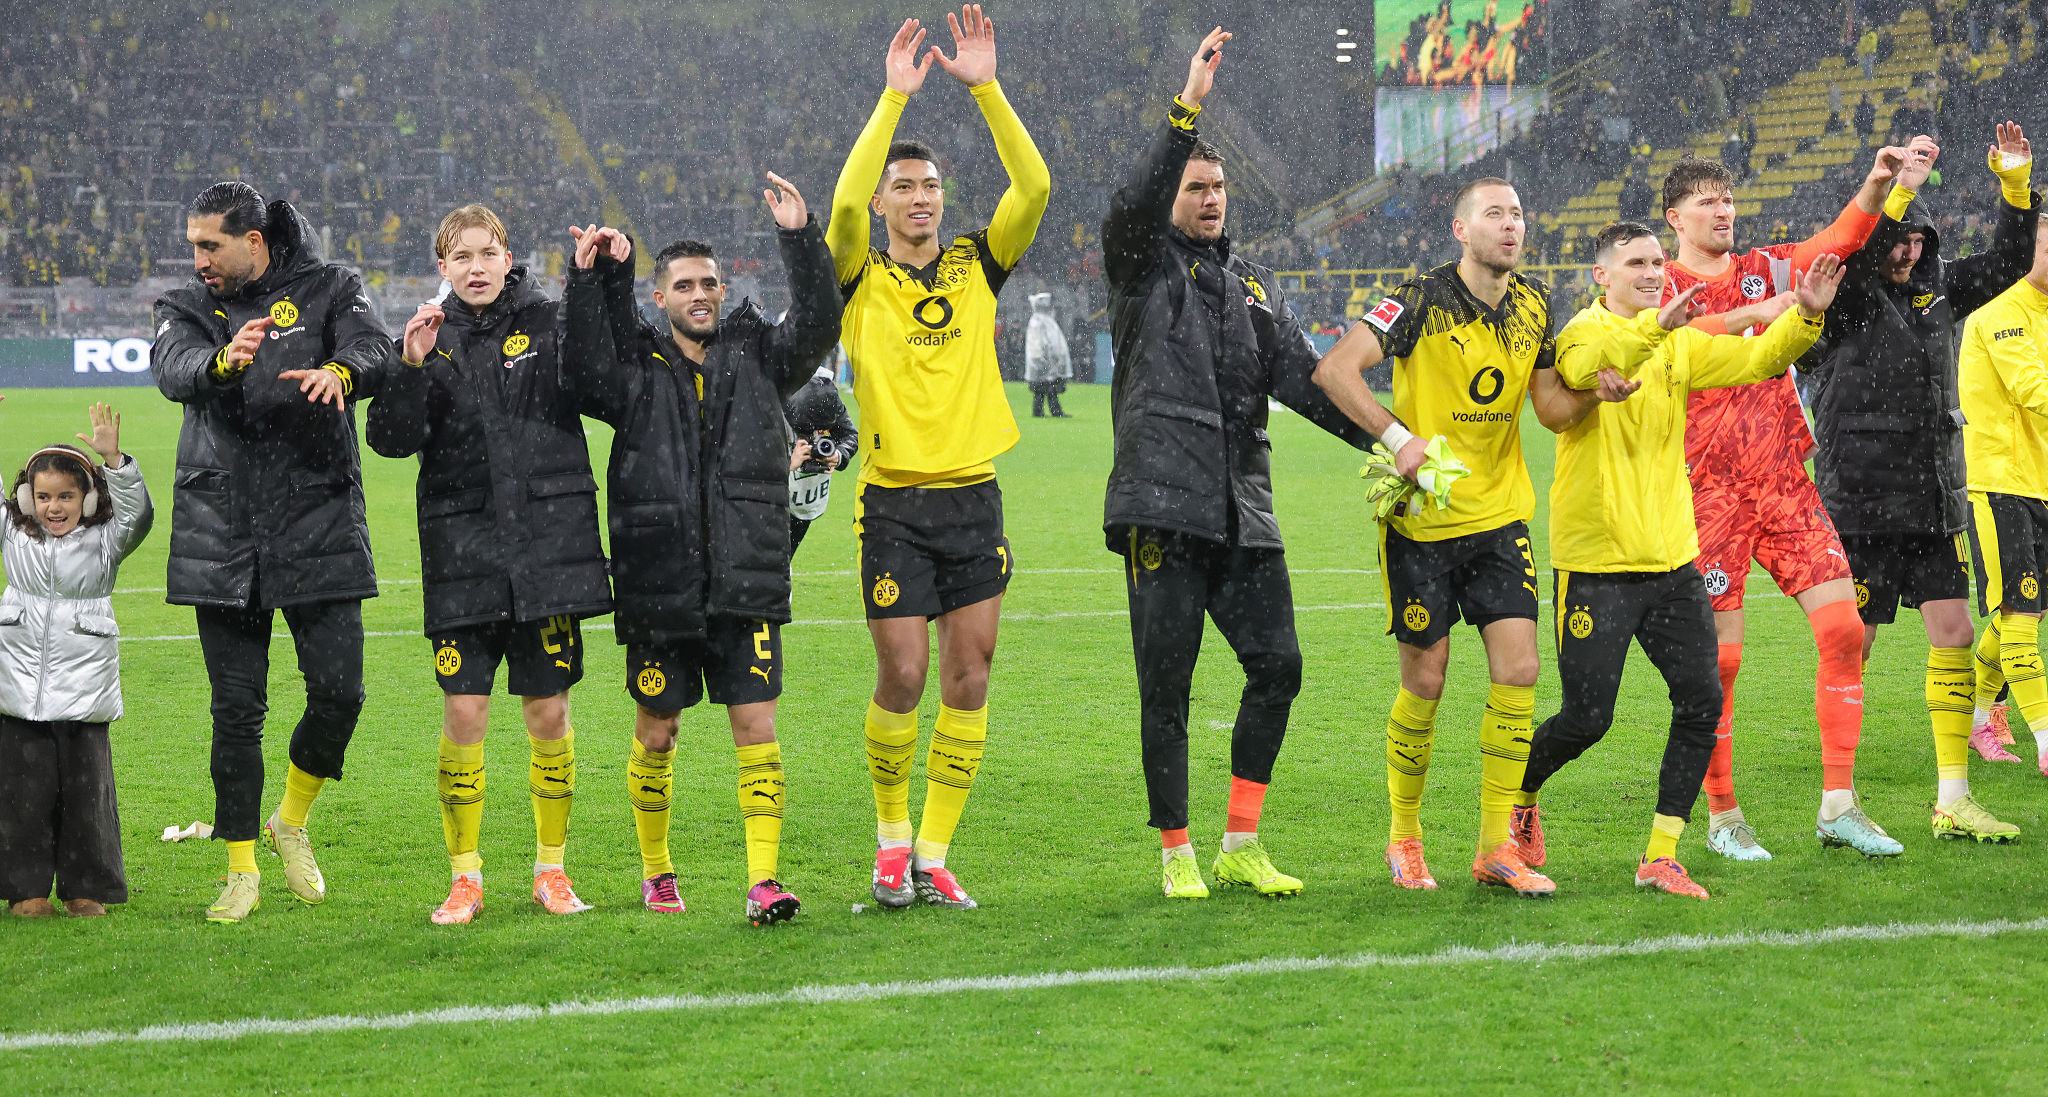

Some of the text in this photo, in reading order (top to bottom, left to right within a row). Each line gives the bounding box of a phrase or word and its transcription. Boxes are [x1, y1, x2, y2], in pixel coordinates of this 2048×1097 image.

[948, 267, 967, 284] BVB
[1743, 278, 1764, 296] BVB
[275, 304, 296, 320] BVB
[905, 328, 962, 346] vodafe
[1994, 327, 2024, 342] REWE
[506, 337, 527, 352] BVB
[1514, 335, 1532, 352] BVB
[73, 337, 155, 373] RO
[1452, 410, 1513, 423] vodafone
[996, 546, 1008, 575] 7
[1143, 545, 1160, 561] BVB
[1514, 536, 1536, 577] 3
[1706, 571, 1726, 588] BVB
[2023, 577, 2037, 593] BVB
[876, 581, 897, 601] BVB
[1407, 607, 1427, 623] BVB
[1572, 615, 1590, 631] BVB
[753, 618, 772, 660] 2
[439, 650, 459, 668] BVB
[642, 671, 662, 689] BVB
